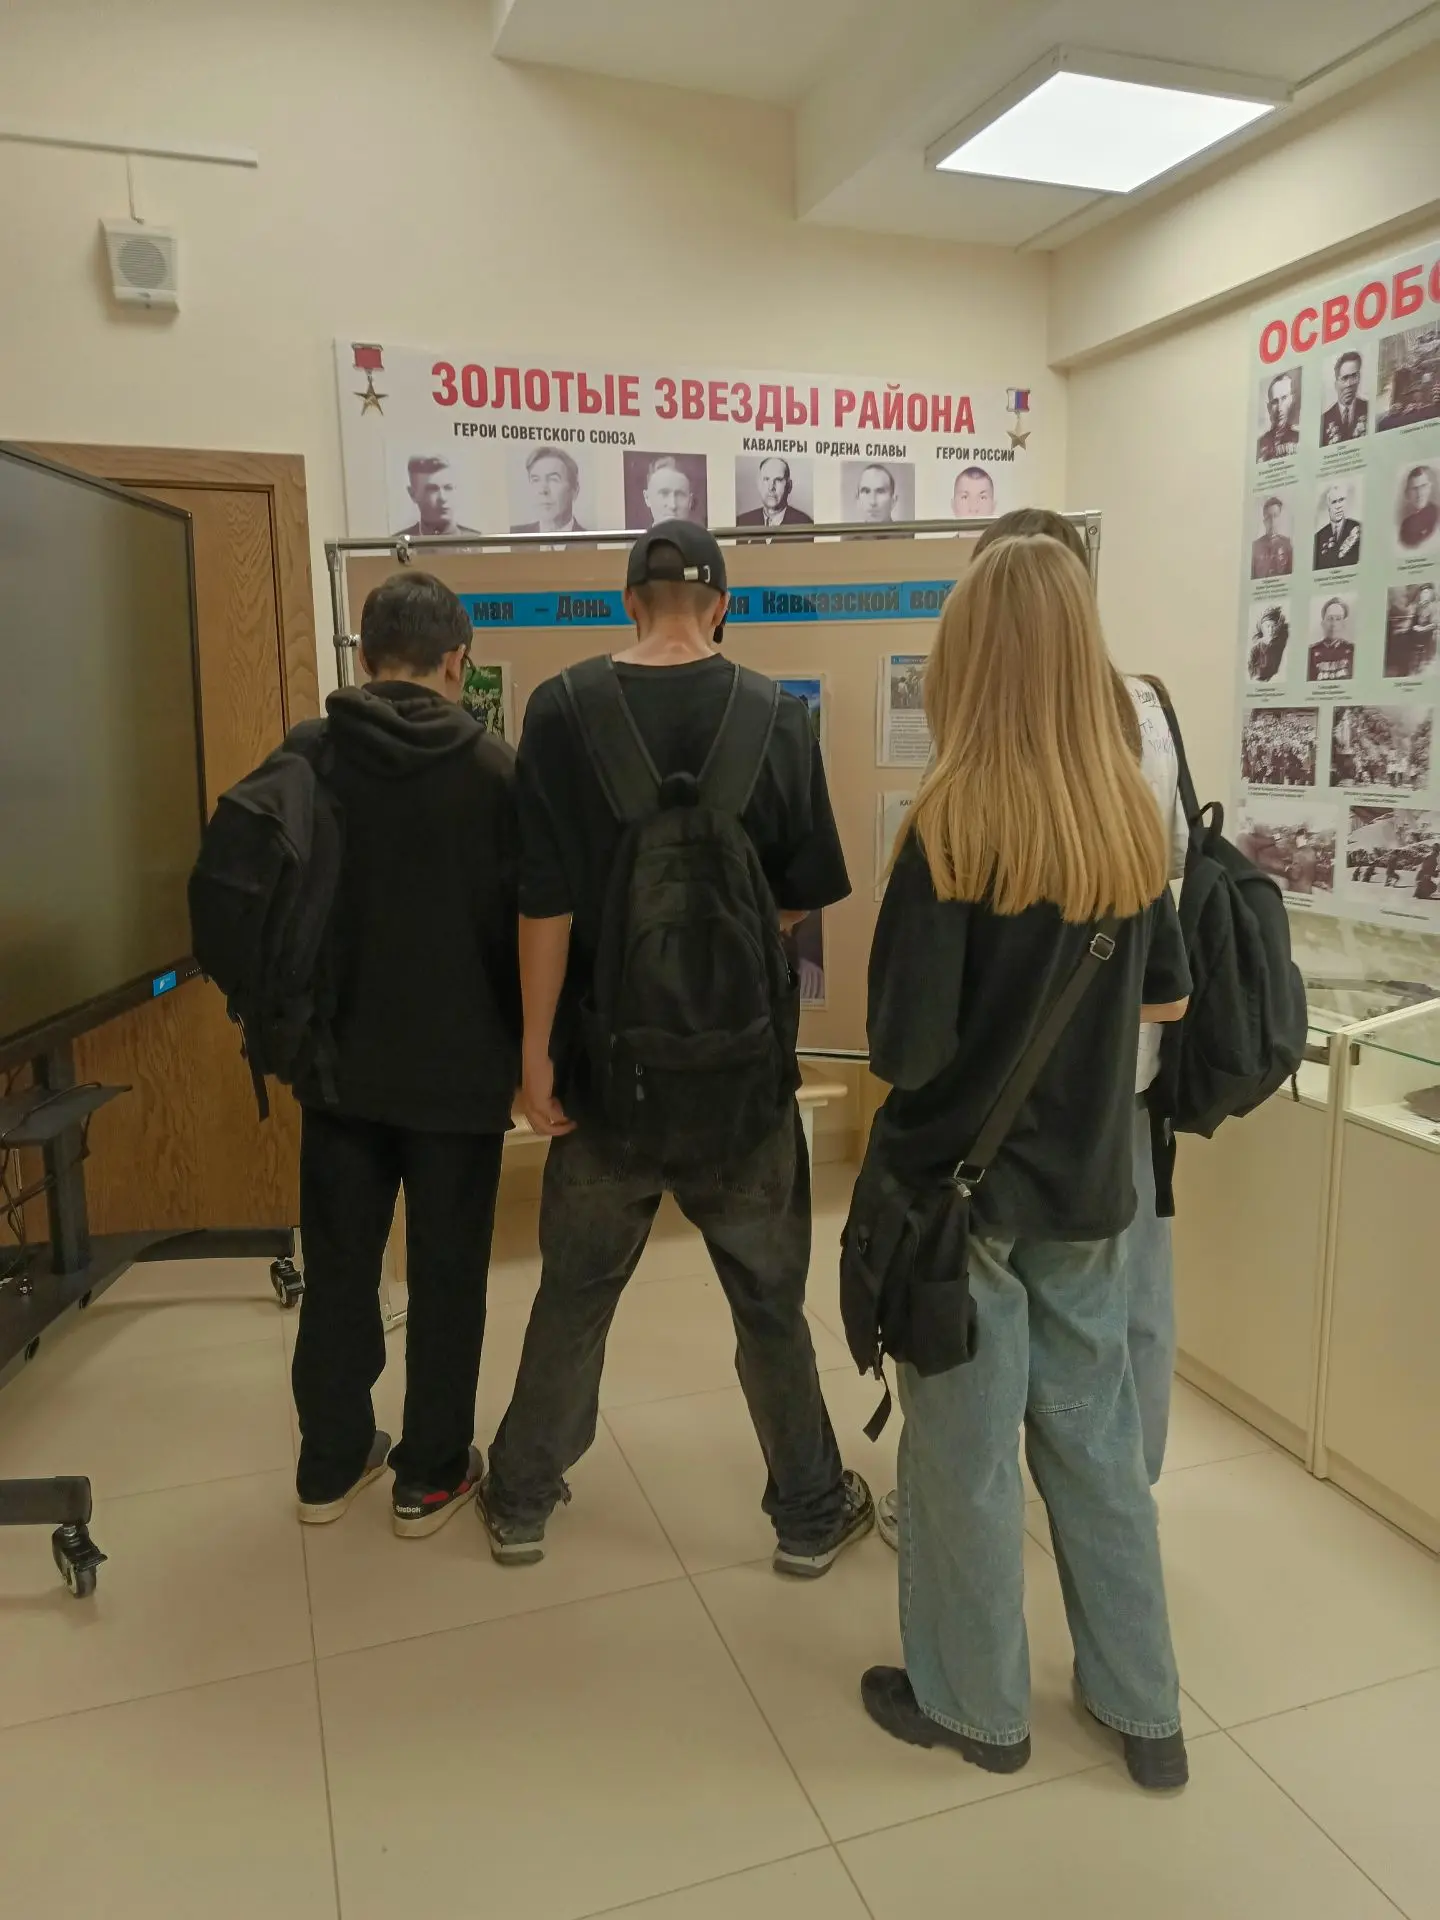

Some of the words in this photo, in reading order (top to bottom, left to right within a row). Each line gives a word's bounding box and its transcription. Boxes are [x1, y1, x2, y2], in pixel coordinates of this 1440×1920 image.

[431, 361, 640, 417] ЗОЛОТЫЕ
[655, 377, 819, 432] ЗВЕЗДЫ
[834, 383, 976, 434] РАЙОНА
[454, 422, 497, 438] ГЕРОИ
[501, 424, 586, 443] СОВЕТСКОГО
[589, 430, 636, 446] СОЮЗА
[743, 437, 808, 453] КАВАЛЕРЫ
[815, 441, 860, 457] ОРДЕНА
[865, 443, 907, 458] СЛАВЫ
[936, 447, 970, 460] ГЕРОИ
[973, 448, 1015, 462] РОССИИ
[473, 602, 513, 620] мая
[556, 595, 611, 621] День
[762, 586, 900, 614] Кавказской
